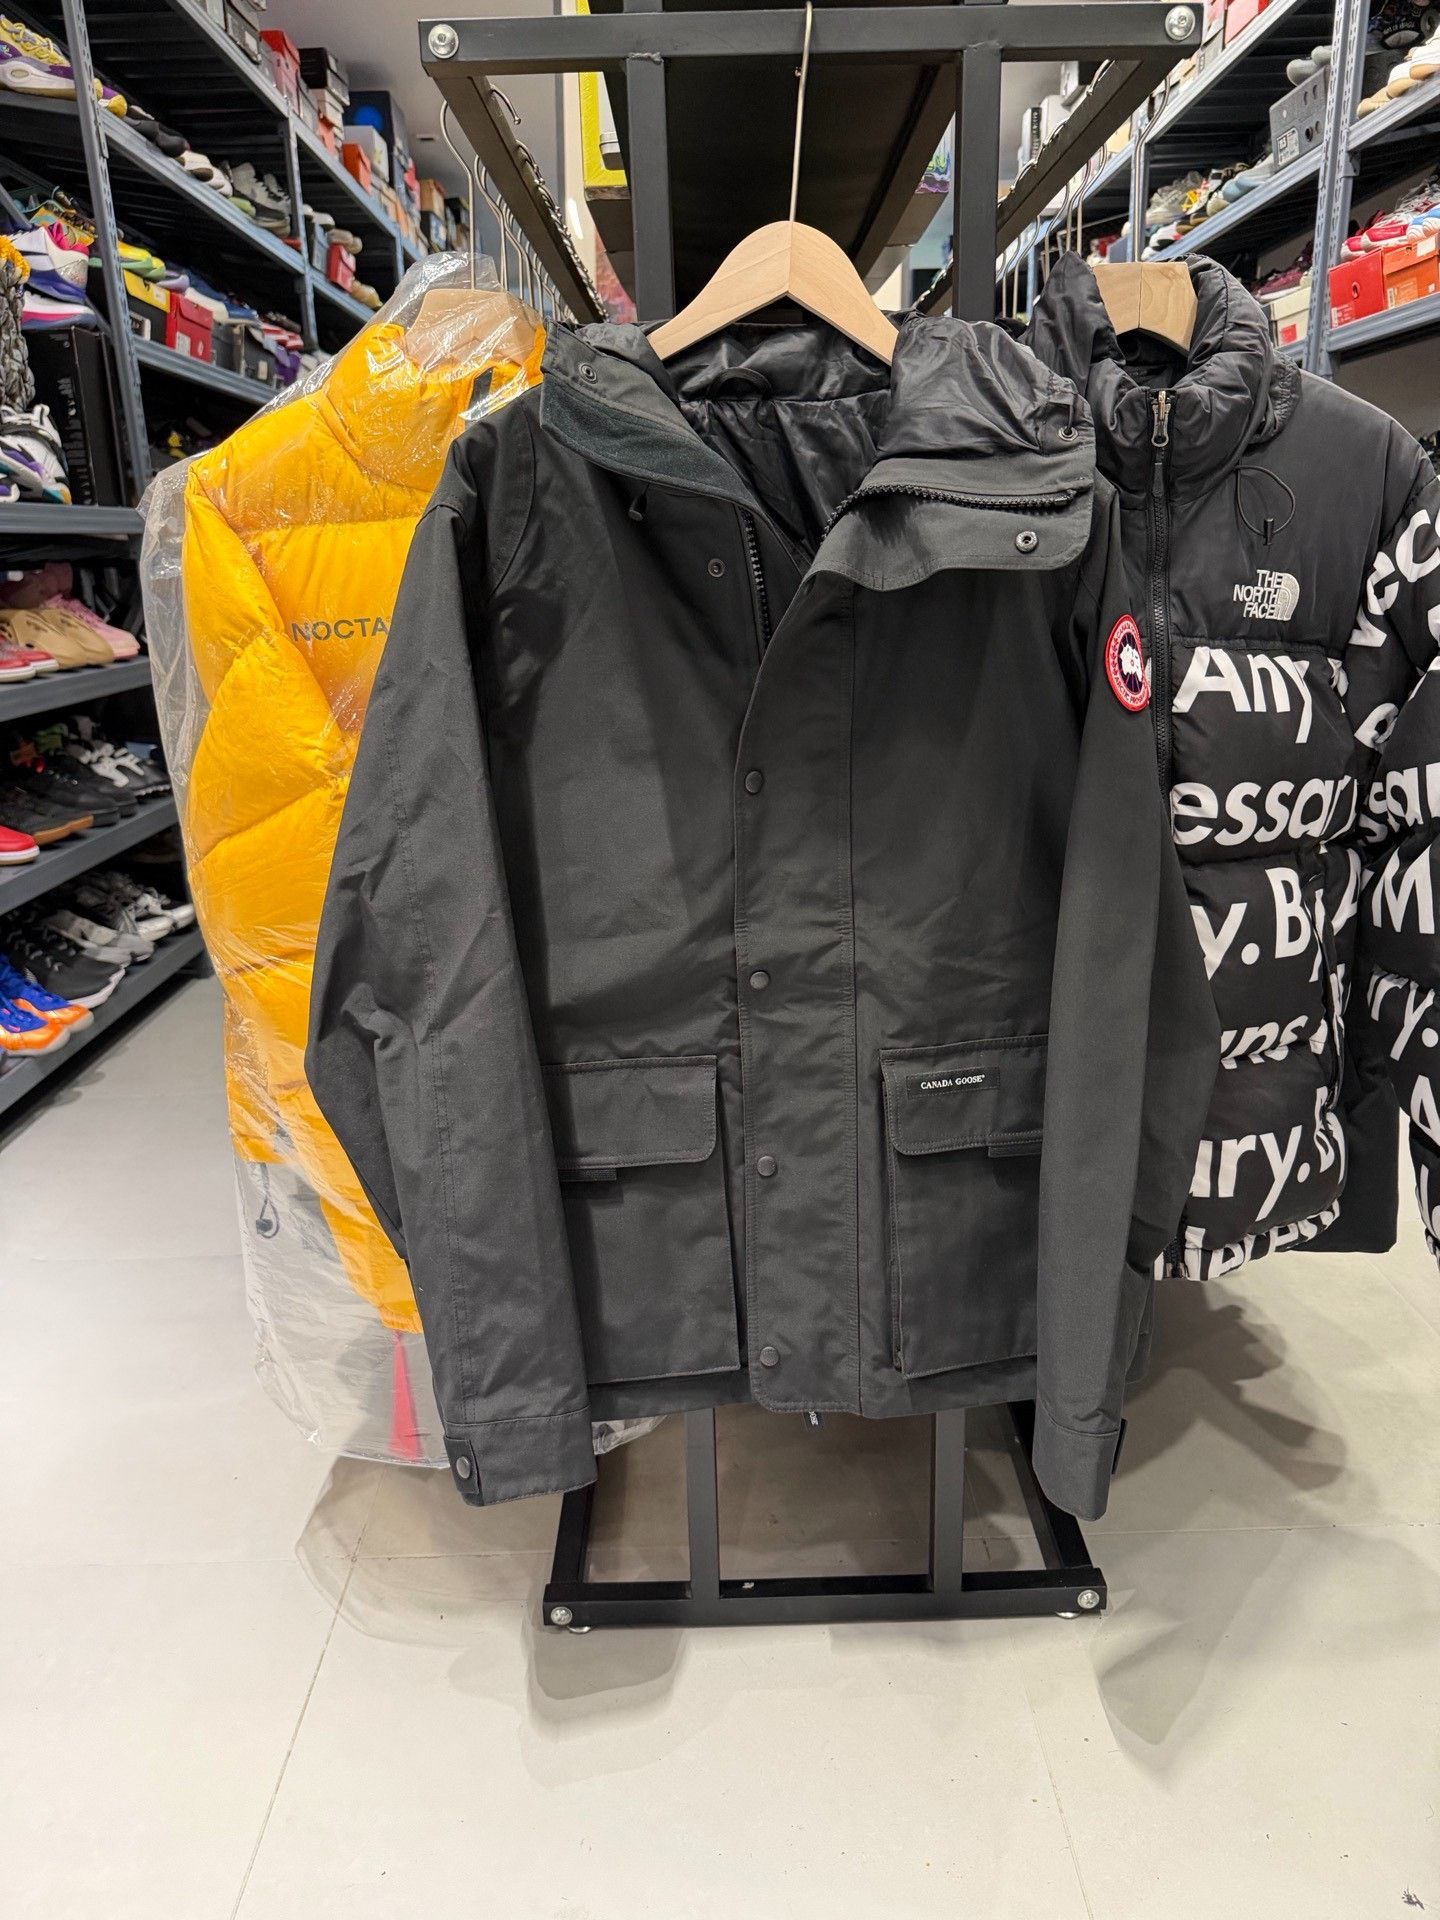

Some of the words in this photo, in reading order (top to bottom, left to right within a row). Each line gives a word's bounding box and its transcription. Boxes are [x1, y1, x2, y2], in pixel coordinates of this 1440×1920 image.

[1257, 569, 1283, 588] THE
[1233, 584, 1280, 605] NORTH
[1243, 602, 1277, 620] FACE
[291, 616, 389, 641] NOCTA
[1171, 646, 1312, 743] Any
[920, 1079, 953, 1090] CANADA
[955, 1075, 983, 1085] GOOSE
